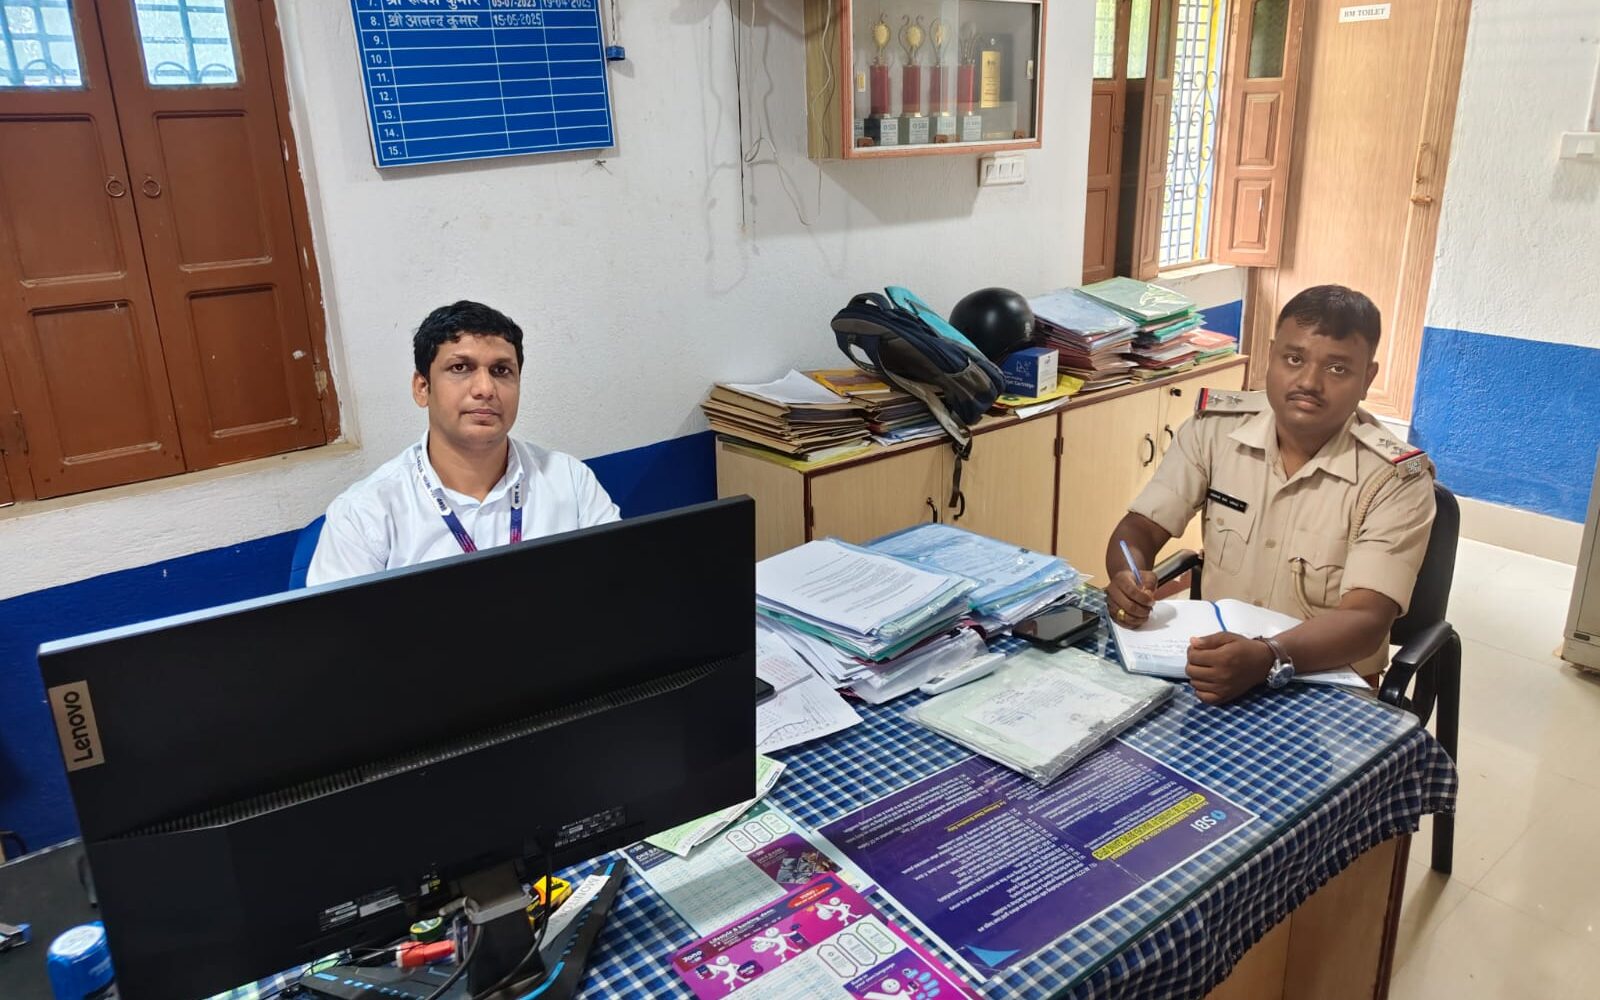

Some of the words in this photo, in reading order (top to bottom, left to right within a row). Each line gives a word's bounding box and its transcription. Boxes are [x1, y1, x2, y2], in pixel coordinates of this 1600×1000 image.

[1358, 8, 1385, 16] TOILET
[370, 16, 380, 26] 8.
[388, 12, 403, 27] श्री
[446, 14, 480, 30] कुमार
[373, 35, 384, 45] 9.
[371, 54, 388, 64] 10.
[377, 73, 390, 82] 11.
[379, 92, 392, 101] 12.
[383, 110, 396, 120] 13.
[384, 128, 399, 138] 14.
[388, 146, 402, 156] 15.
[64, 691, 93, 763] Lenovo
[1190, 816, 1217, 832] SBI
